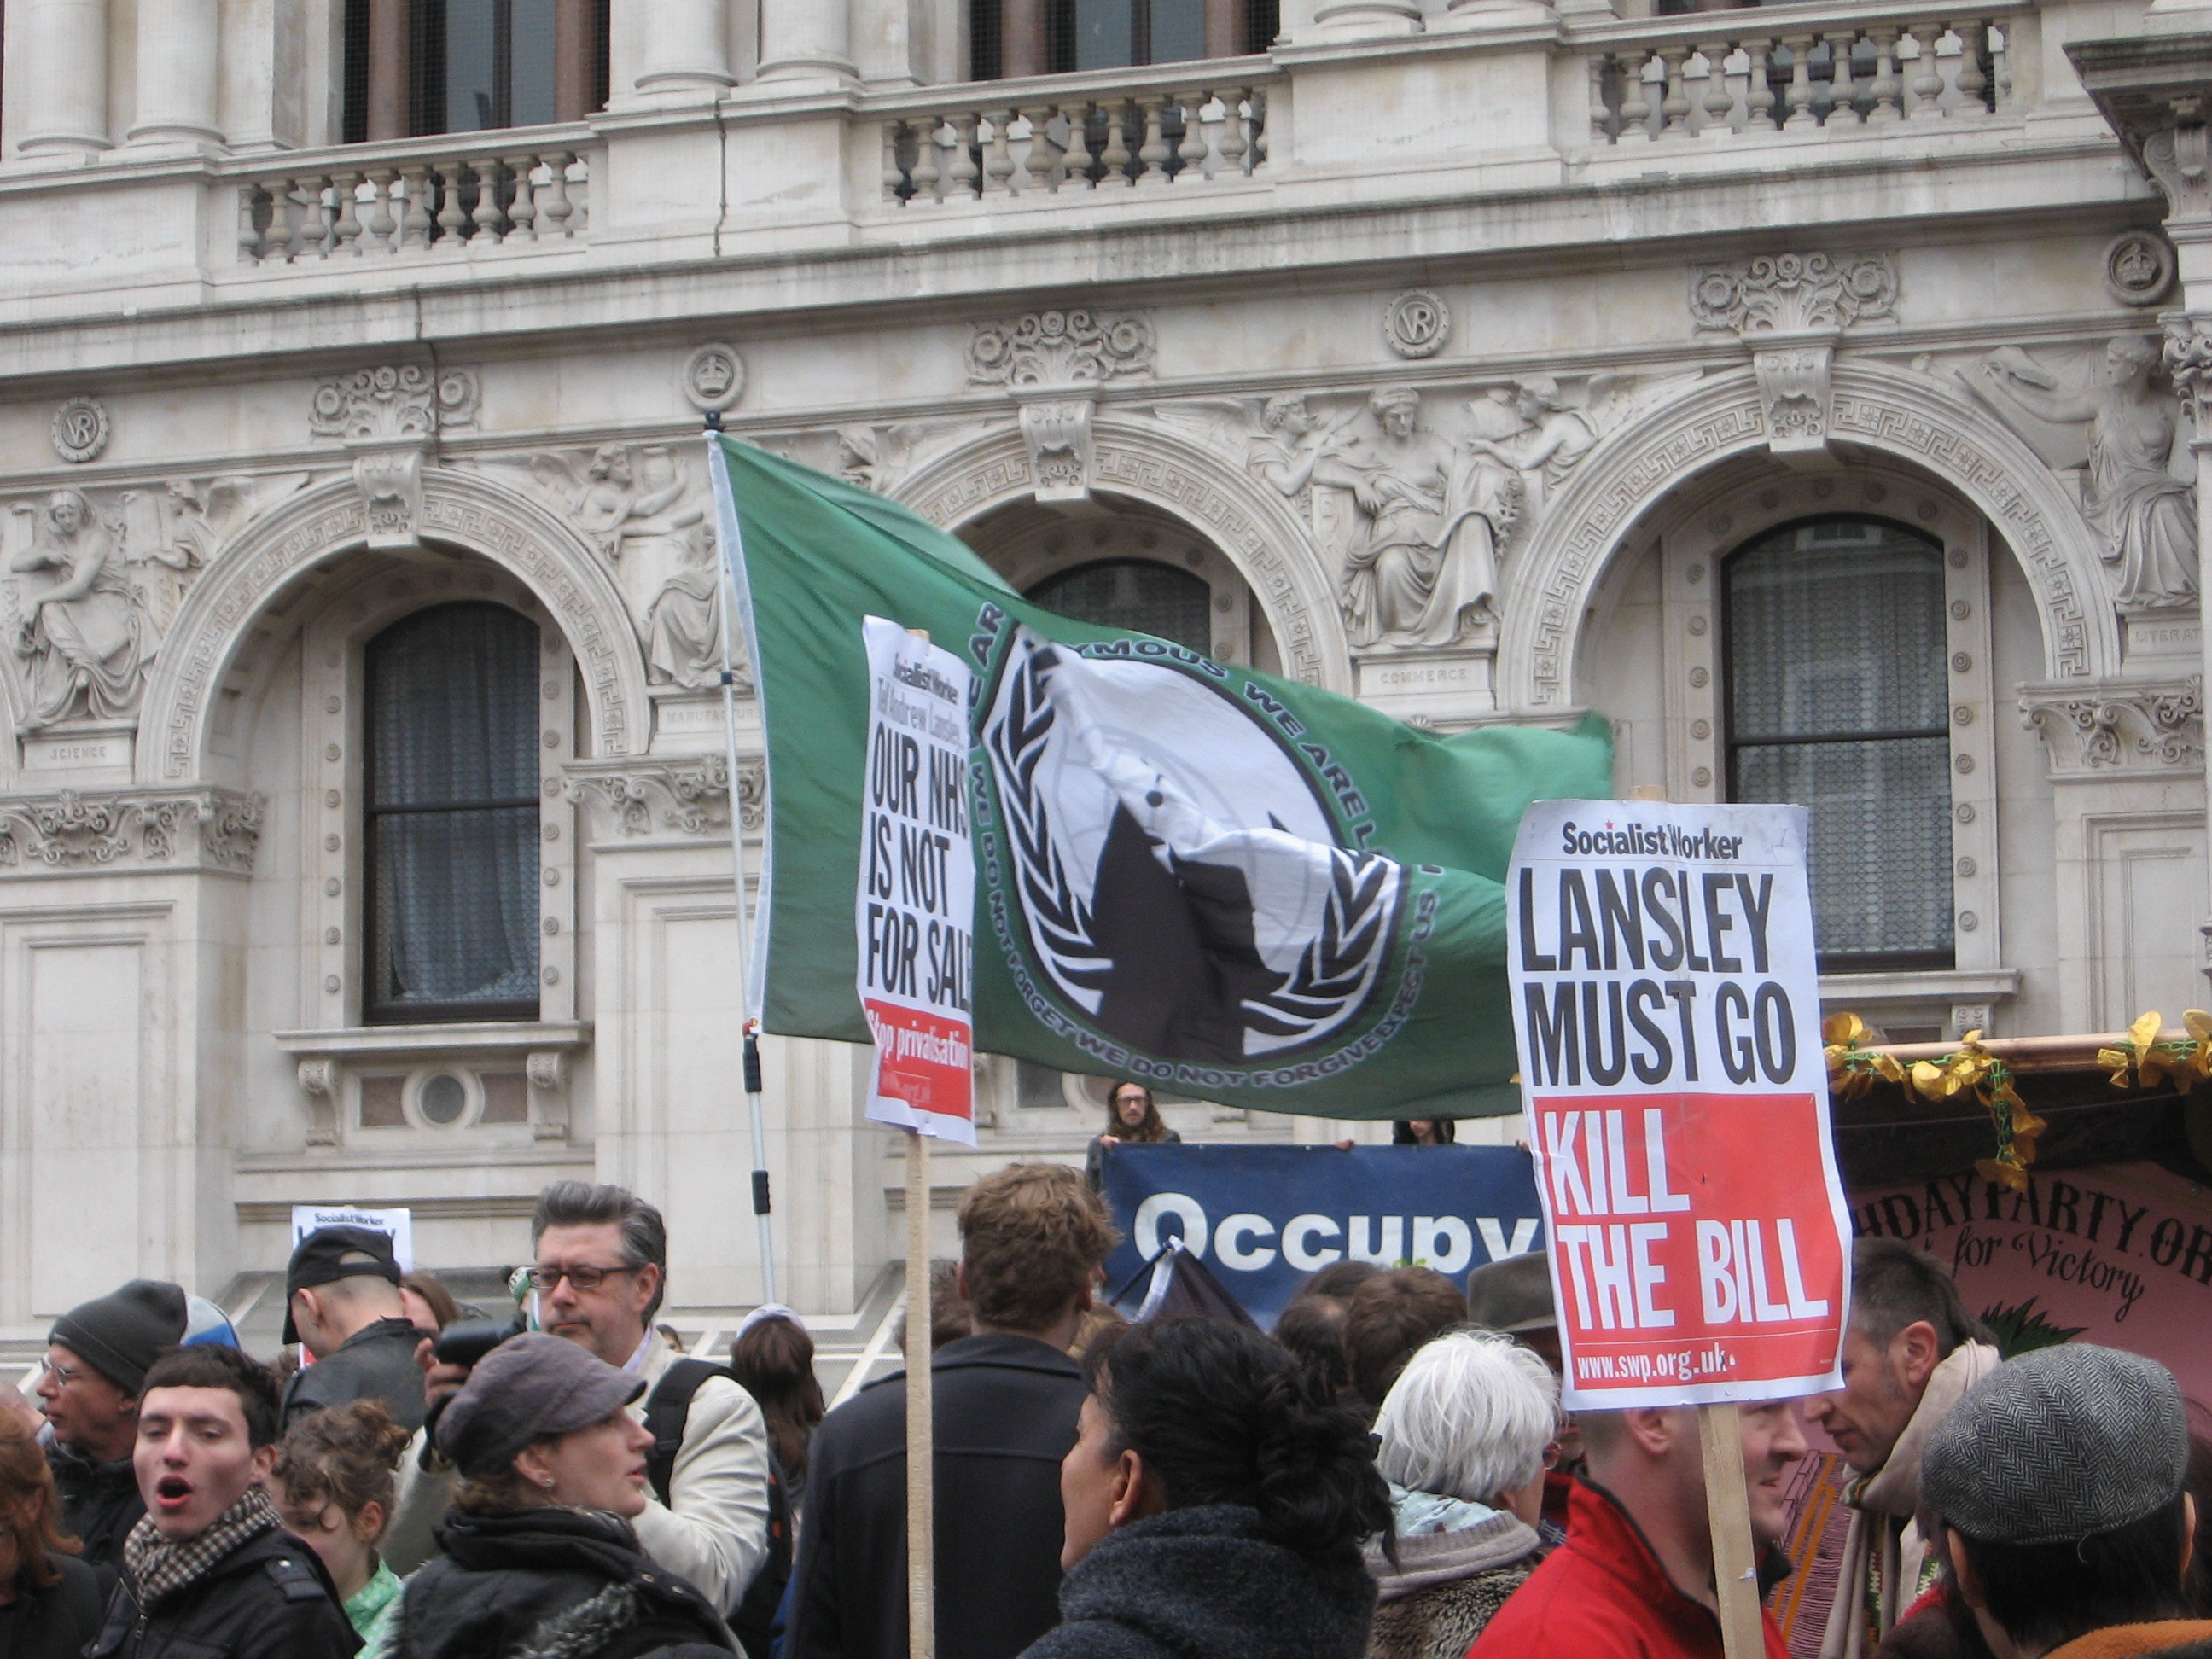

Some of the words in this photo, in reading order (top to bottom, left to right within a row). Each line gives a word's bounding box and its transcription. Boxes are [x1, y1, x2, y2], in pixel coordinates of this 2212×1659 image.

[969, 602, 1005, 671] AR
[1244, 681, 1306, 738] WE
[1298, 742, 1368, 819] ARE
[1380, 668, 1467, 684] COMMERCE
[51, 746, 106, 760] SCIENCE
[872, 721, 919, 820] OUR
[929, 743, 969, 840] NHS
[868, 811, 893, 900] IS
[900, 822, 951, 917] NOT
[982, 832, 999, 887] DO
[867, 901, 919, 998] FOR
[989, 889, 1015, 951] NOT
[1409, 889, 1439, 941] US
[1519, 866, 1773, 974] LANSLEY
[1007, 951, 1078, 1037] FORGET
[1371, 946, 1429, 1039] EXPECT
[1523, 978, 1699, 1086] MUST
[1715, 981, 1796, 1086] GO
[1076, 1027, 1129, 1068] WE
[1128, 1056, 1174, 1080] DO
[1176, 1064, 1247, 1088] NOT
[1251, 1034, 1384, 1087] FORGIVE
[1543, 1108, 1691, 1216] KILL
[1133, 1192, 1540, 1275] Occupy
[1557, 1221, 1675, 1330] THE
[1695, 1218, 1829, 1324] BILL
[1953, 1223, 2002, 1279] for
[2011, 1230, 2145, 1323] Victory
[1576, 1342, 1728, 1382] www.swp.org.uk
